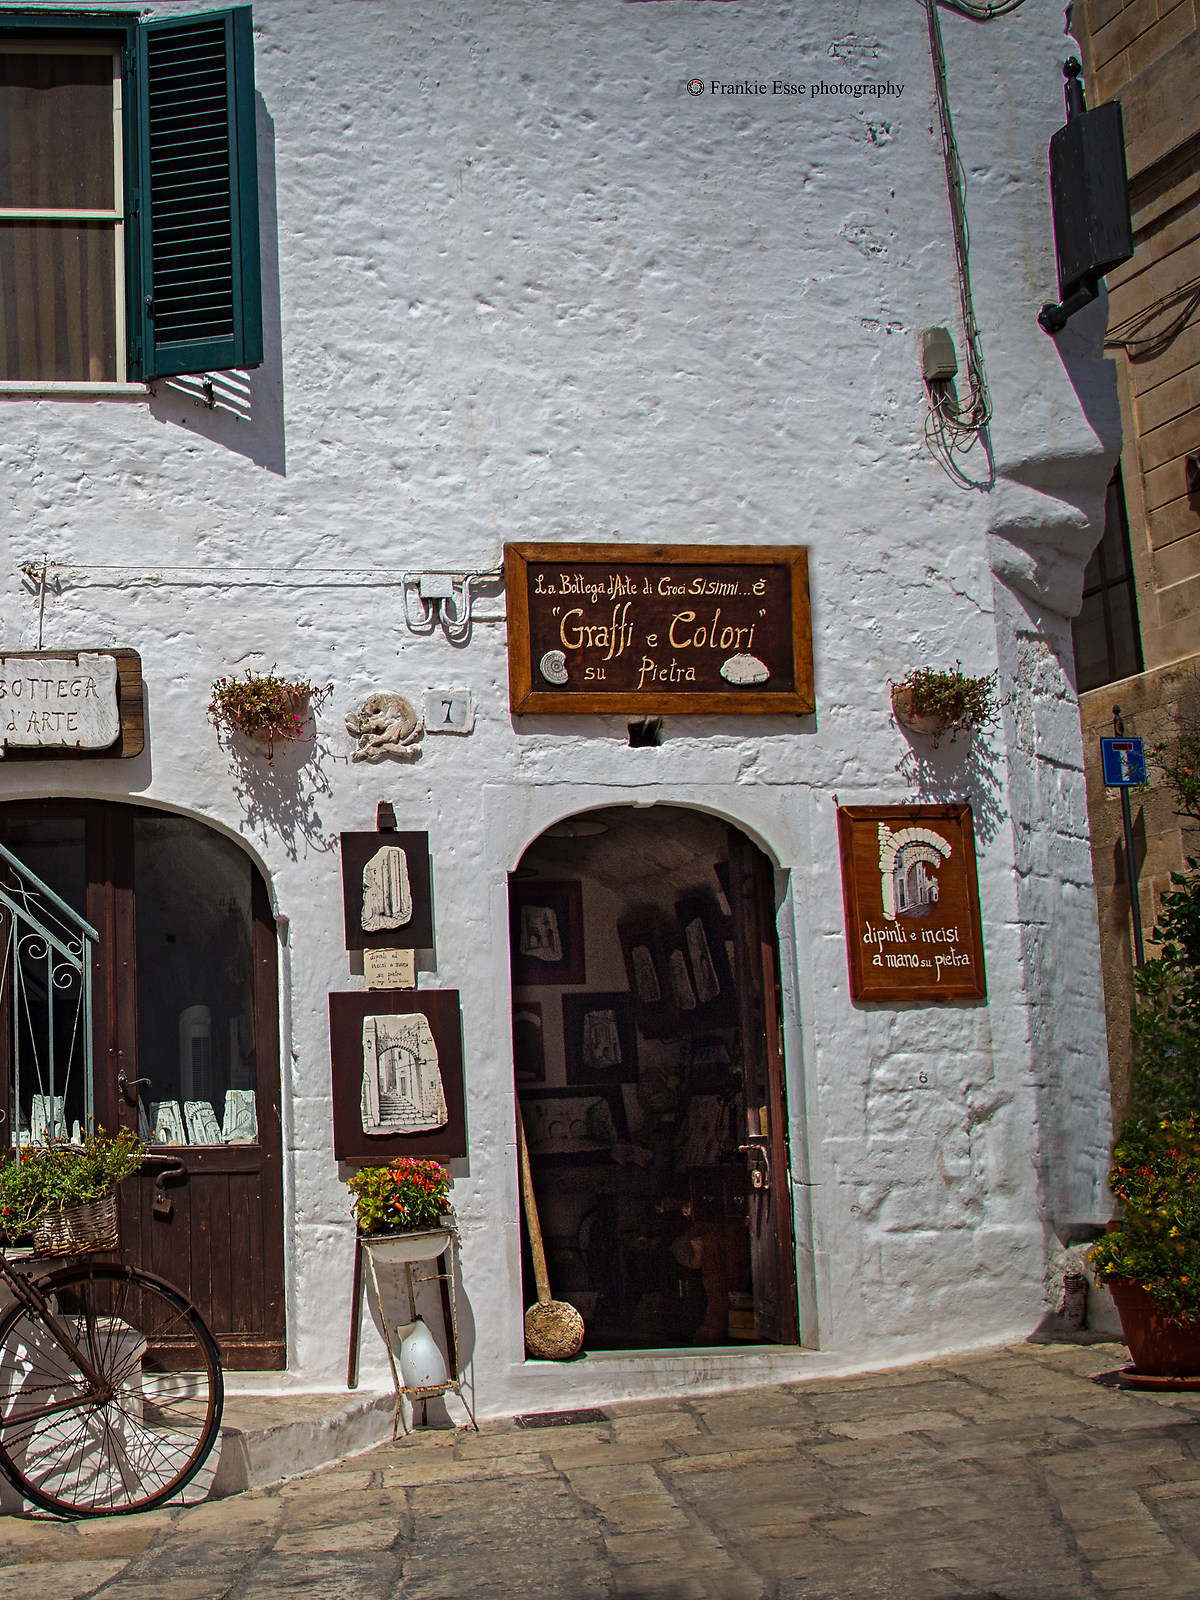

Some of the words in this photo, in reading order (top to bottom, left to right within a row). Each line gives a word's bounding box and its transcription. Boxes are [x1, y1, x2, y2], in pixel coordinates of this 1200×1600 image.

[535, 573, 557, 595] La
[559, 573, 606, 604] Bottega
[642, 576, 653, 595] di
[646, 631, 659, 648] e
[584, 665, 606, 681] su
[6, 709, 79, 735] d'ARTE
[441, 699, 454, 724] 7
[863, 920, 908, 953] dipinti
[909, 932, 918, 941] e
[921, 926, 960, 943] incisi
[872, 953, 884, 967] a
[885, 953, 920, 968] mano
[920, 959, 933, 968] su
[934, 946, 971, 982] pietra
